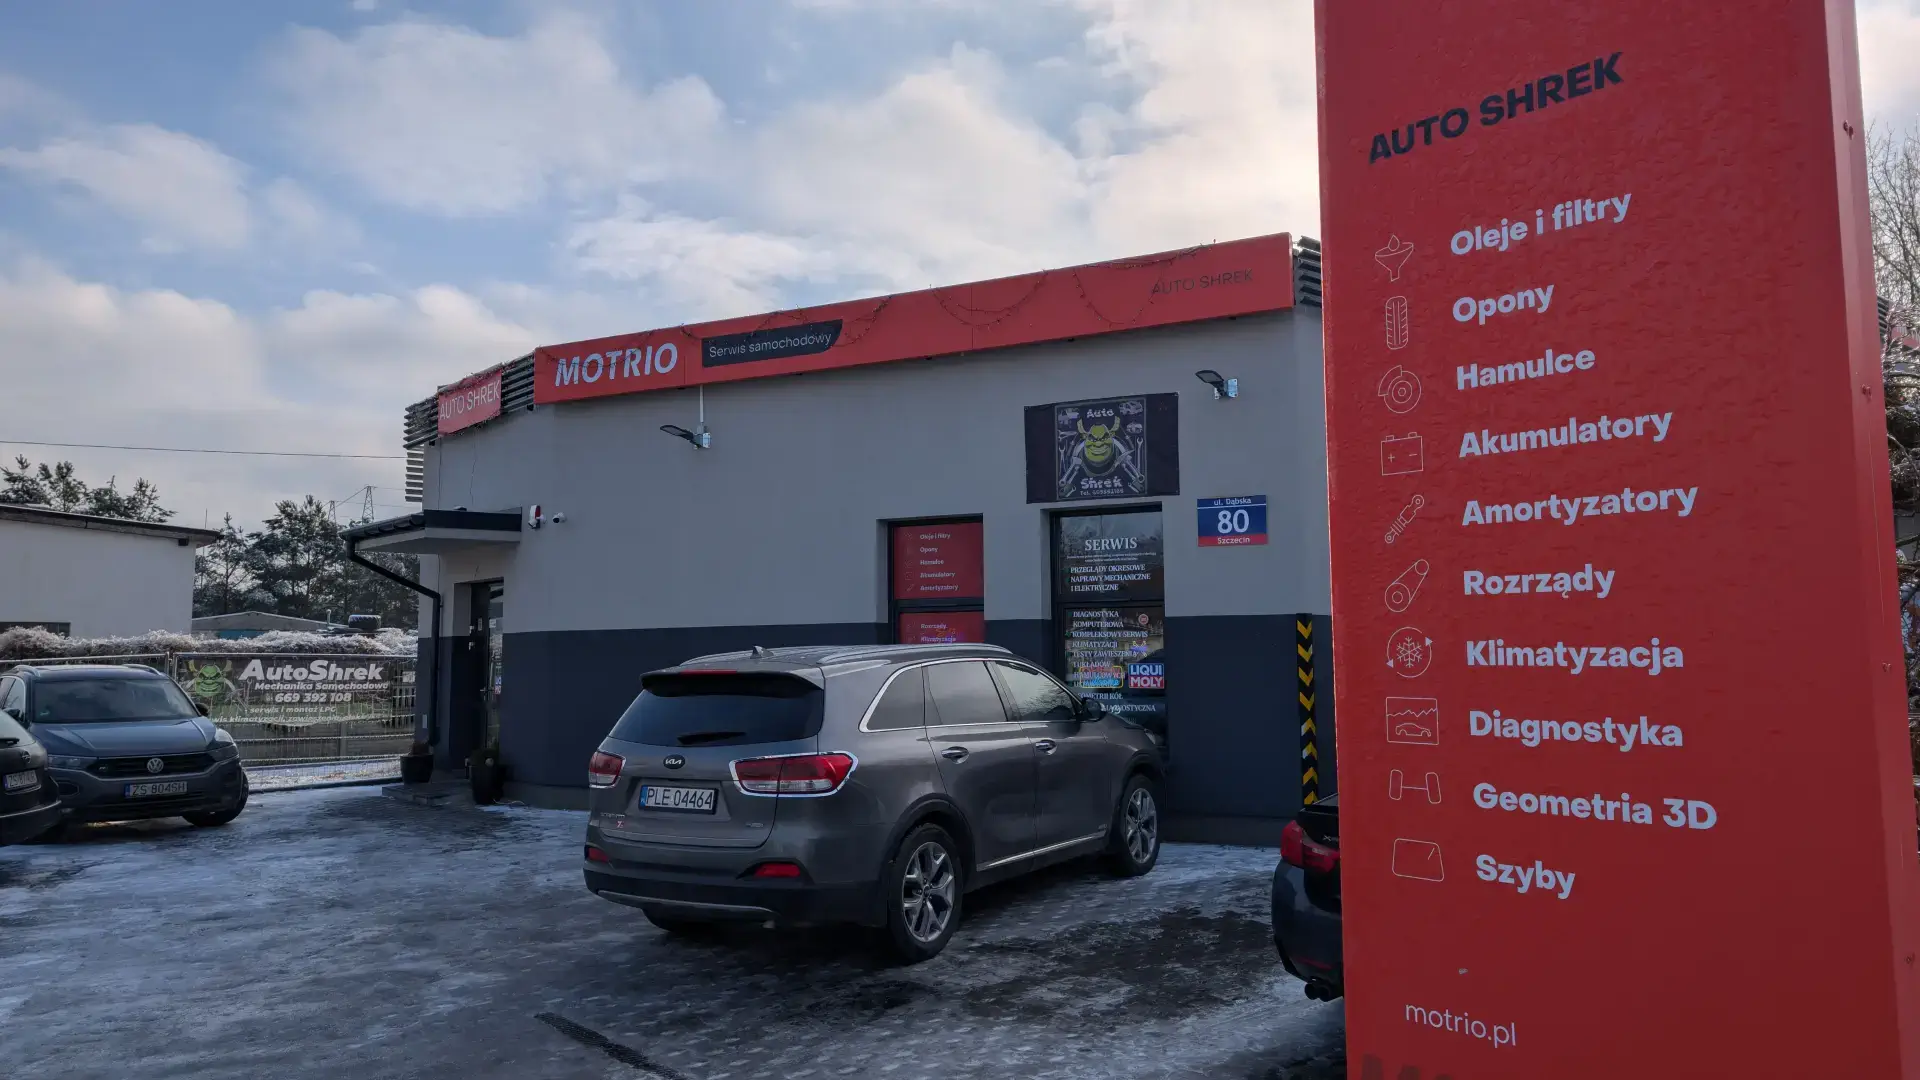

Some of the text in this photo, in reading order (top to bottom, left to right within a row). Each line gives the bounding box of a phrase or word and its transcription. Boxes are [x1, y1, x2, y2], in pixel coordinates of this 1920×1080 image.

[1369, 51, 1623, 164] AUTO SHREK
[1450, 193, 1632, 255] Oleje i filtry
[1152, 268, 1253, 295] AUTO SHREK
[1452, 284, 1555, 325] Opony
[709, 330, 832, 358] Serwis samochodowy
[554, 341, 678, 387] MOTRIO
[1456, 348, 1596, 390] Hamulce
[439, 378, 501, 421] AUTO SHREK
[1086, 408, 1114, 418] Auto
[1459, 411, 1673, 458] Akumulatory
[1080, 477, 1123, 489] Shrek
[1214, 496, 1252, 506] ul. Dąbska
[1461, 486, 1699, 526] Amortyzatory
[1217, 509, 1250, 534] 80
[1085, 537, 1138, 551] SERWIS
[1217, 536, 1250, 545] Szczecin
[1070, 564, 1146, 574] PRZEGLĄDY OKRESOWE
[1104, 573, 1151, 582] MECHANICZNE
[1075, 584, 1119, 592] ELEKTRYCZNE
[1463, 563, 1616, 599] Rozrządy
[1073, 610, 1119, 618] DIAGNOSTYKA
[1072, 641, 1118, 649] KLIMATYZACJI
[1122, 630, 1149, 638] SERWIS
[1073, 650, 1092, 658] TESTY
[1466, 637, 1684, 676] Klimatyzacja
[238, 658, 384, 681] AutoShrek
[1130, 665, 1162, 676] LIQUI
[255, 682, 389, 691] Mechanika Samochodowa
[1130, 676, 1162, 687] MOLY
[275, 692, 352, 703] 669 392 108
[1469, 709, 1683, 752] Diagnostyka
[132, 785, 147, 796] ZS
[646, 788, 713, 809] PLE 04464
[1473, 782, 1717, 830] Geometria 3D
[1476, 854, 1576, 900] Szyby
[1405, 1004, 1516, 1048] motrio.pl
